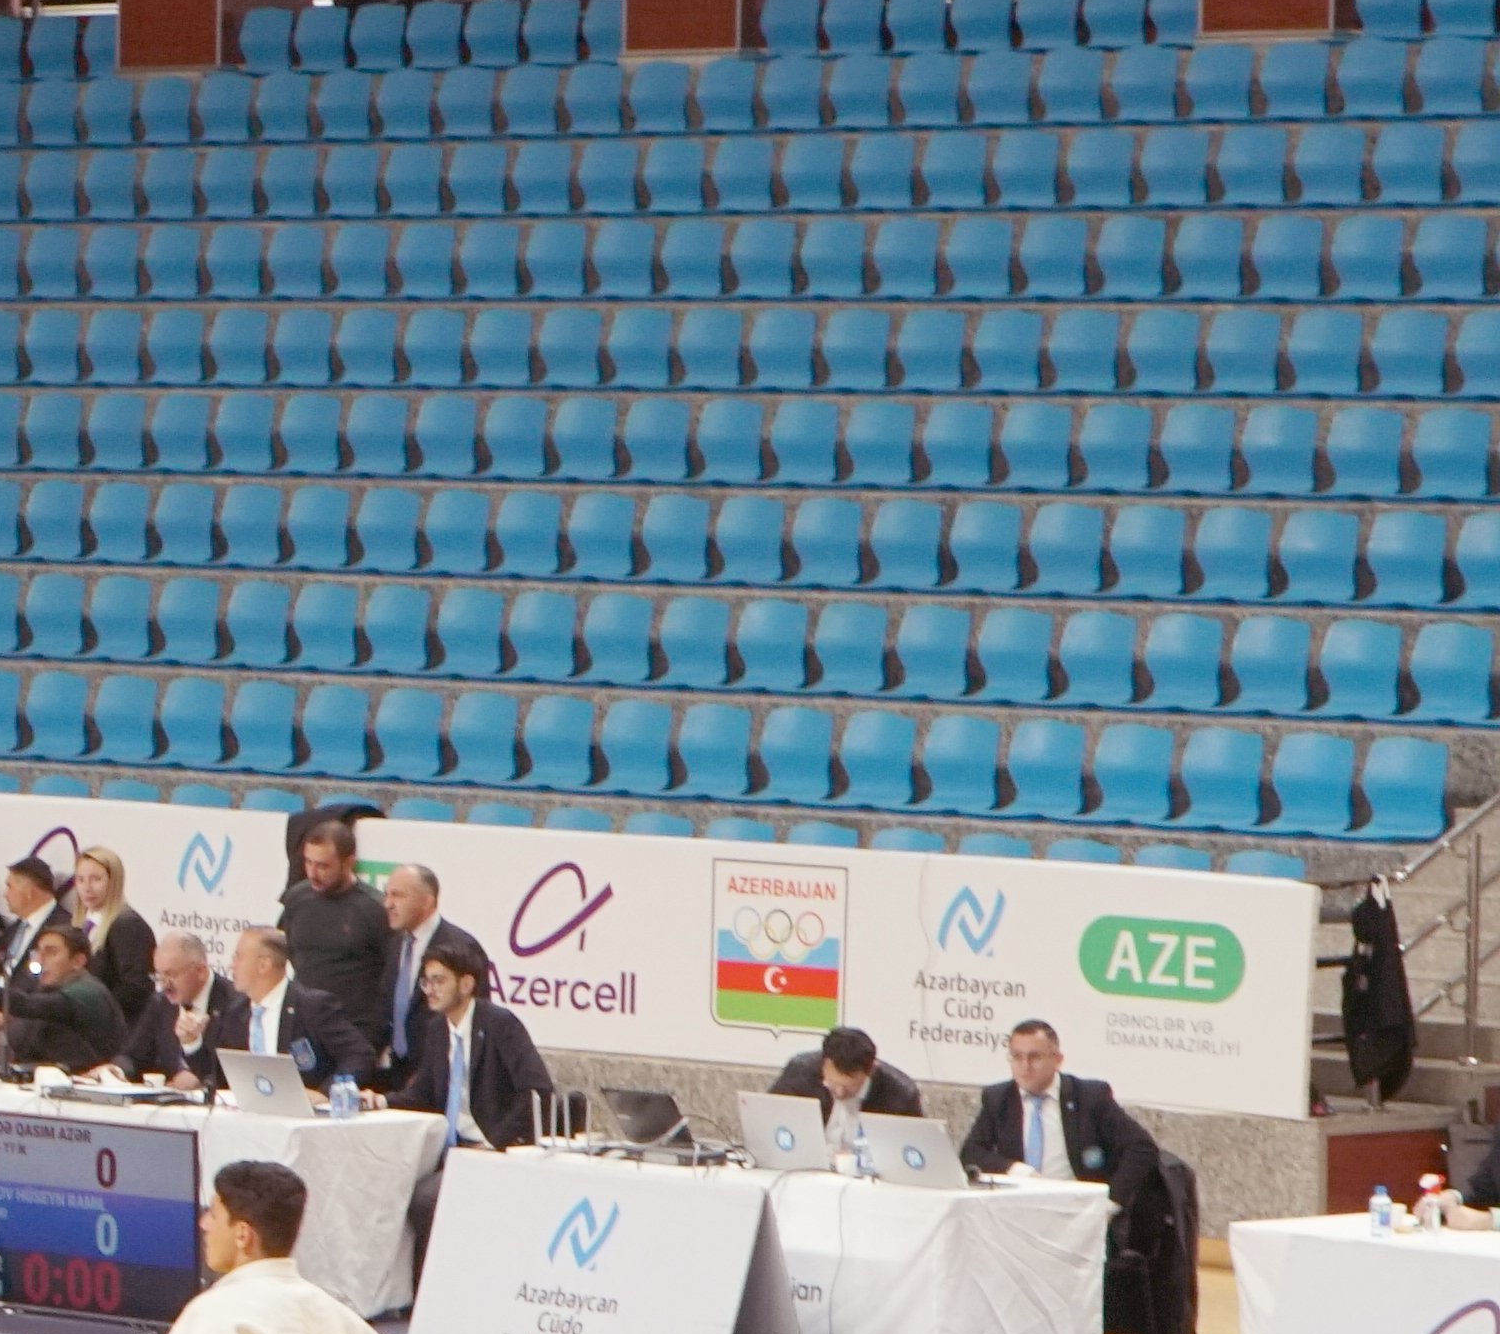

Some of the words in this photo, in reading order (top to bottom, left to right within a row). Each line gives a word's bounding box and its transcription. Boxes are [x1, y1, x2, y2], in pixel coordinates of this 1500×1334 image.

[728, 876, 835, 900] AZERBAIJAN
[1106, 932, 1216, 990] AZE
[486, 961, 636, 1014] Azercell
[914, 970, 1026, 998] Azərbaycan
[944, 998, 994, 1021] Cüdo
[909, 1021, 1010, 1052] Federasiya
[96, 1147, 117, 1189] 0
[95, 1213, 119, 1256] 0
[23, 1252, 122, 1312] 0:00
[515, 1282, 617, 1315] Azərbaycan
